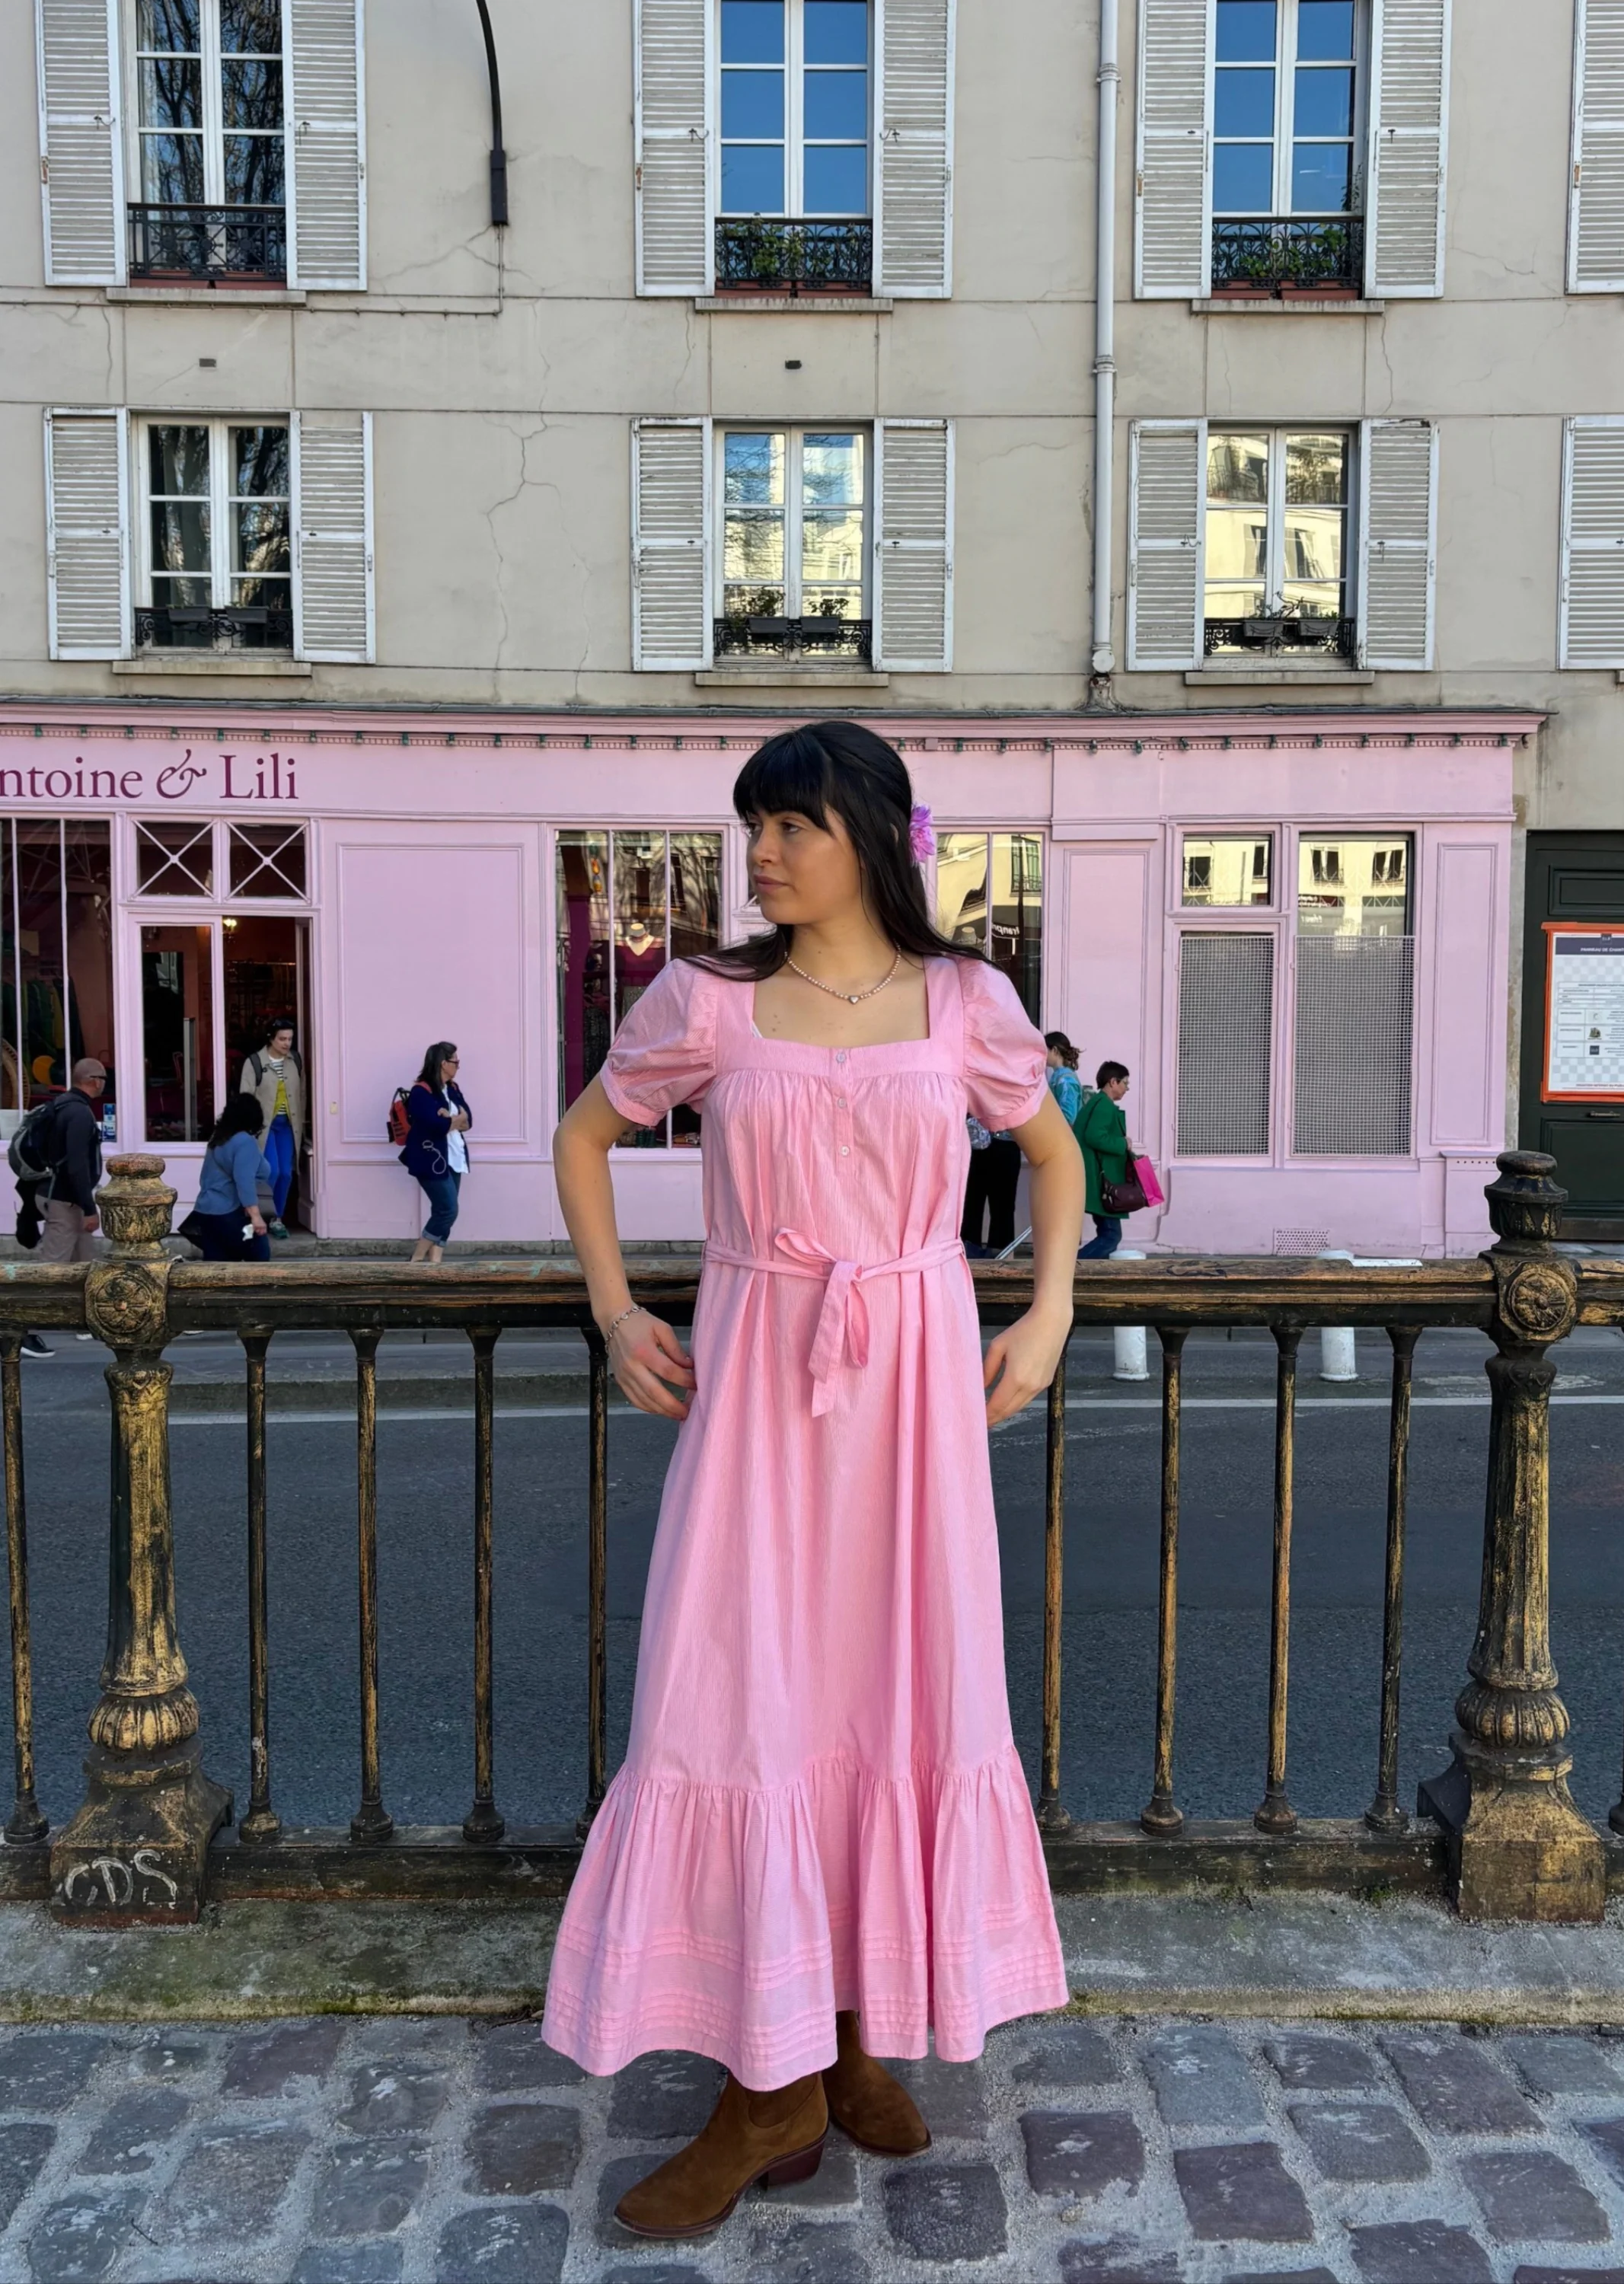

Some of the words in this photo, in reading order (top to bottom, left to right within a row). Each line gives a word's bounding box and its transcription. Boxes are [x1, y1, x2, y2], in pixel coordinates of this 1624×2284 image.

[0, 756, 143, 799] ntoine
[156, 748, 207, 799] &
[219, 752, 299, 799] Lili
